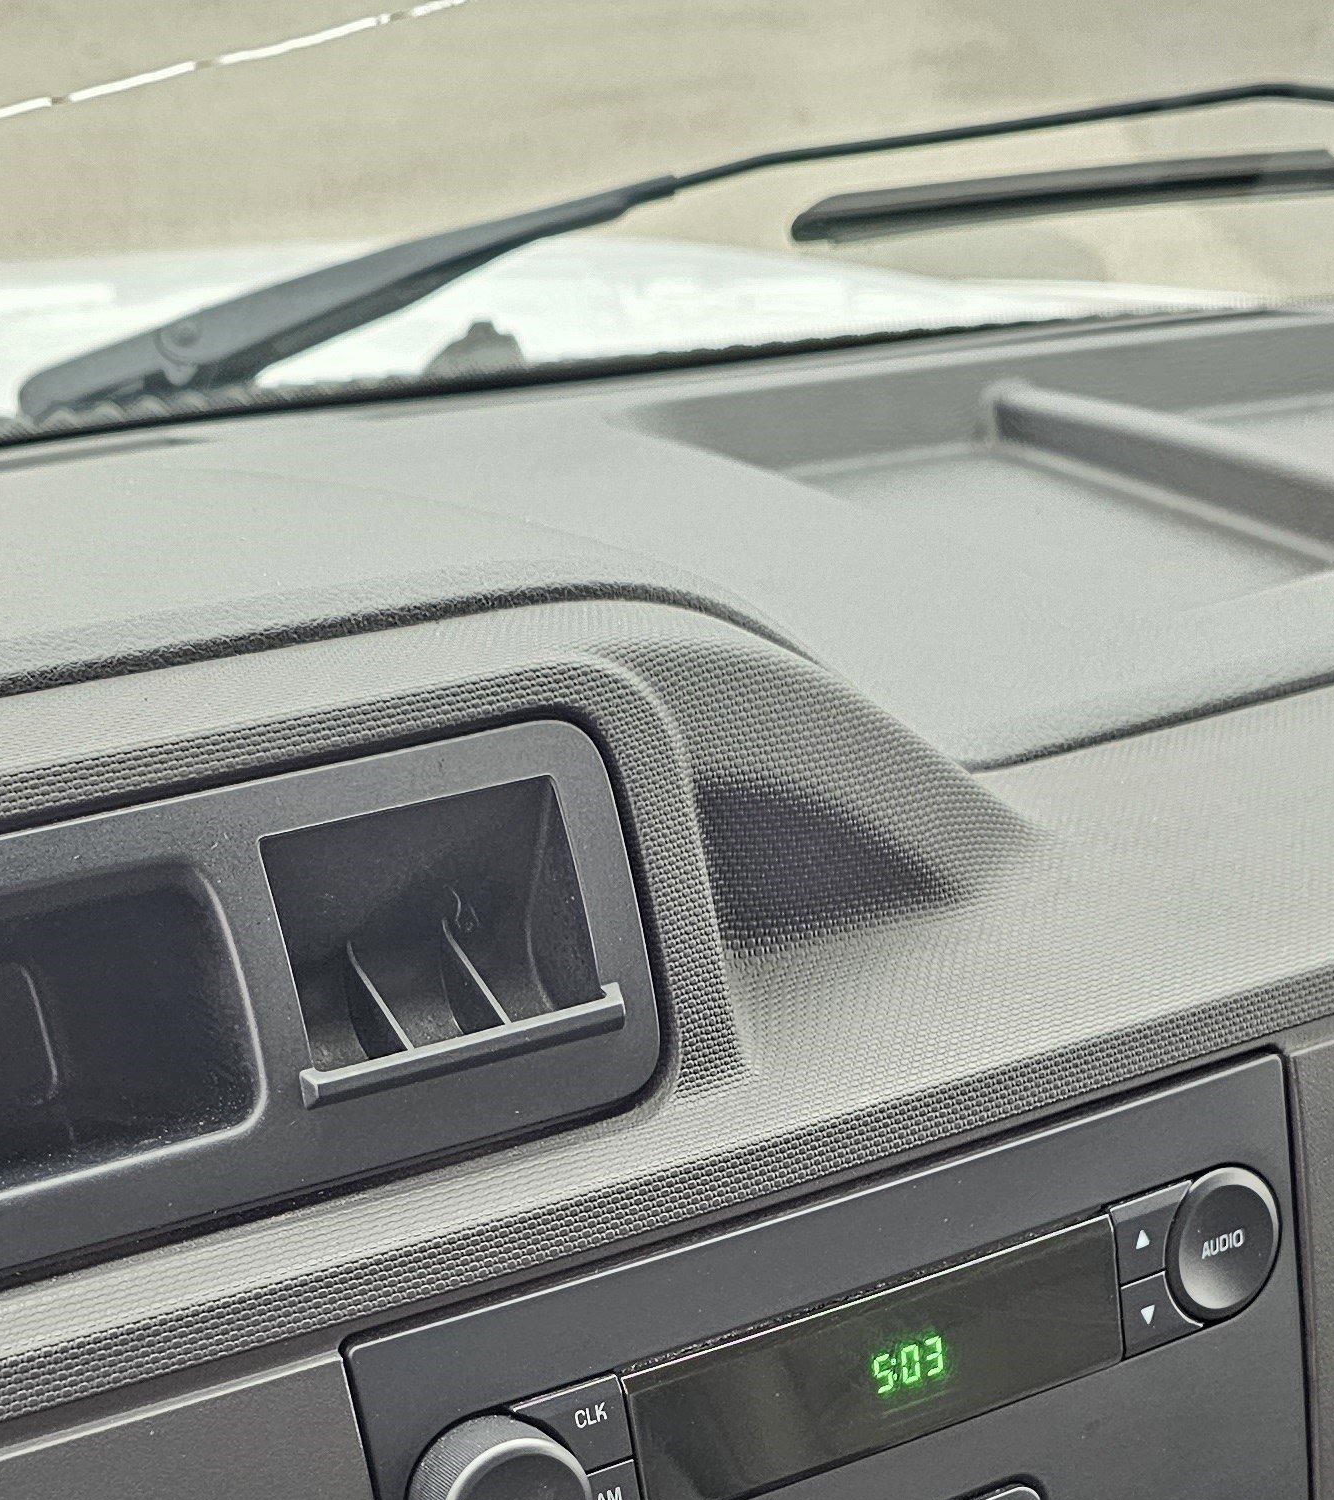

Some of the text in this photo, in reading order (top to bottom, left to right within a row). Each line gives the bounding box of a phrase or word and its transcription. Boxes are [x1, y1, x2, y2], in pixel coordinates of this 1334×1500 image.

[1201, 1229, 1244, 1260] AUDIO
[873, 1335, 944, 1394] 5:03
[574, 1402, 608, 1429] CLK
